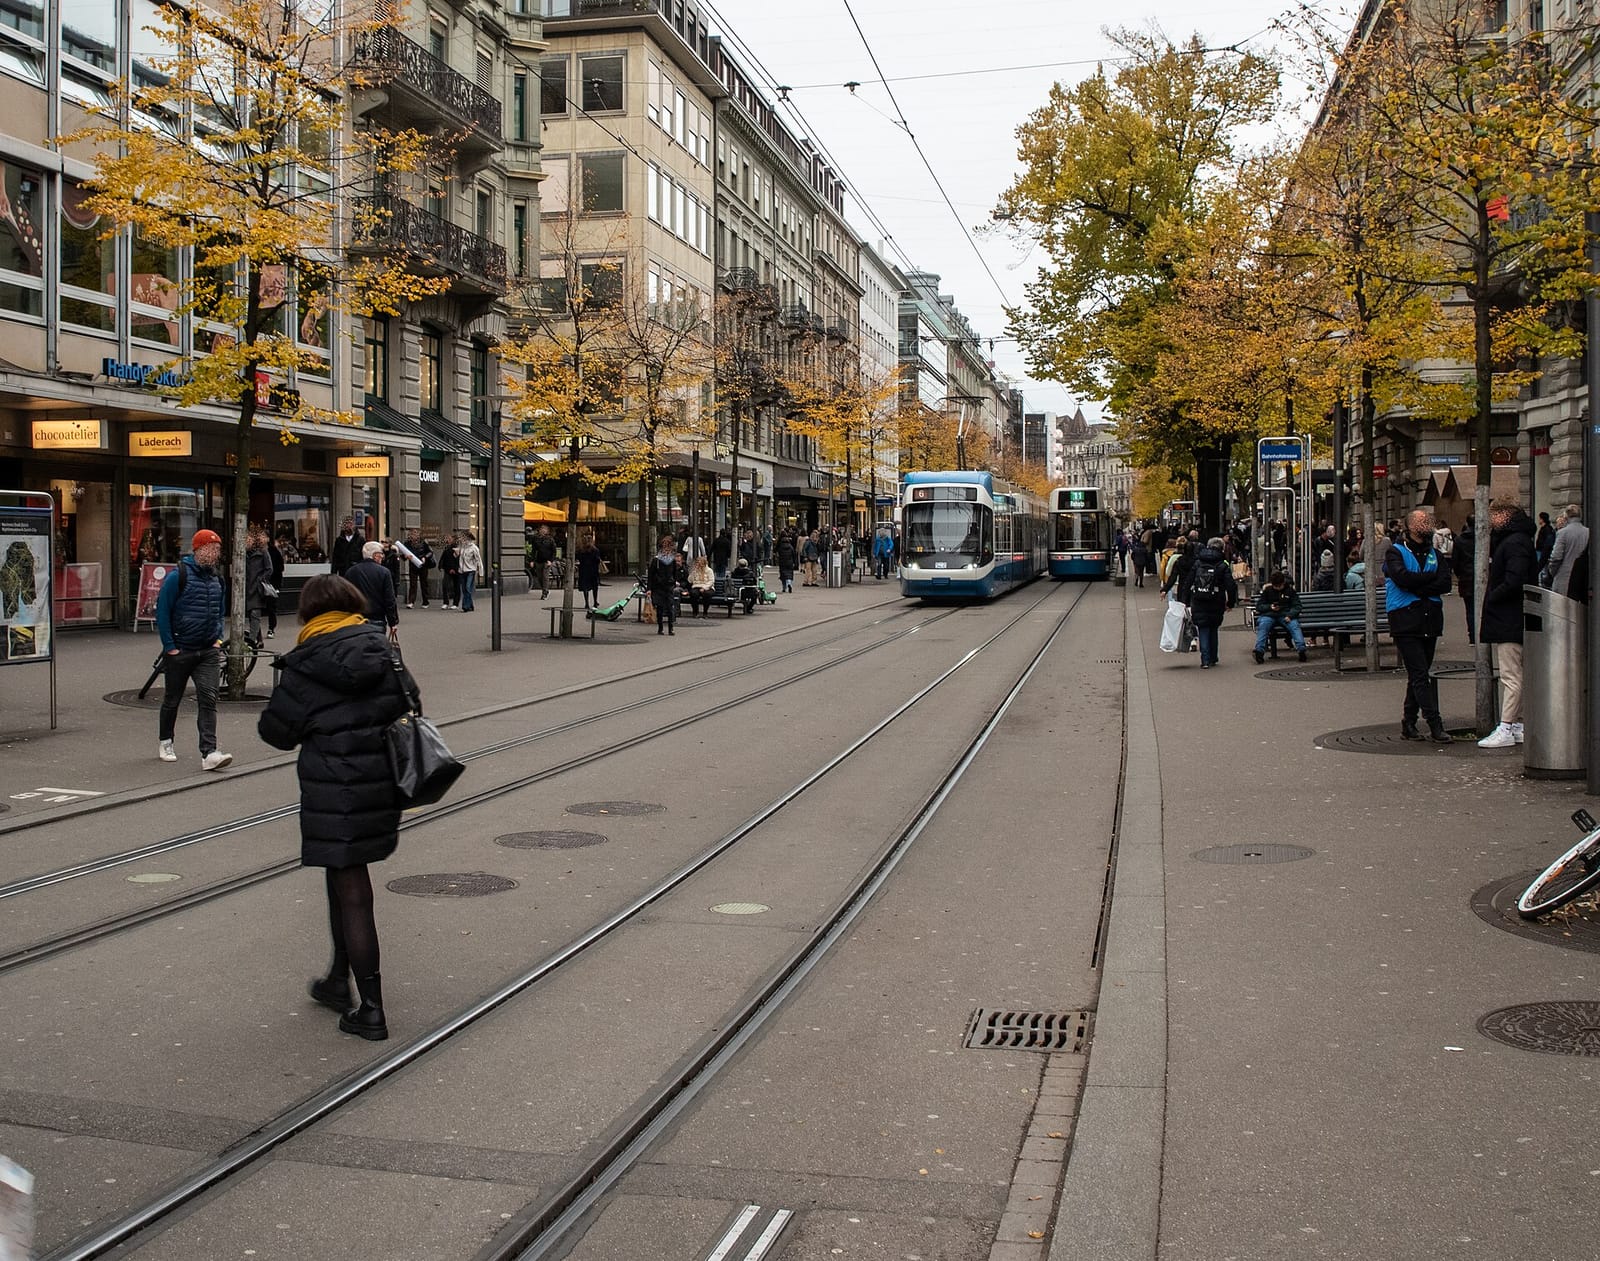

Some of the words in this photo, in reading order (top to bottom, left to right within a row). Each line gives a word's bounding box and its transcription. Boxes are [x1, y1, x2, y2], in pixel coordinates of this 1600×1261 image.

[34, 429, 99, 441] chocoatelier
[138, 437, 182, 447] Läderach
[345, 461, 381, 469] Läderach
[918, 490, 924, 498] 6
[1074, 491, 1082, 500] 11
